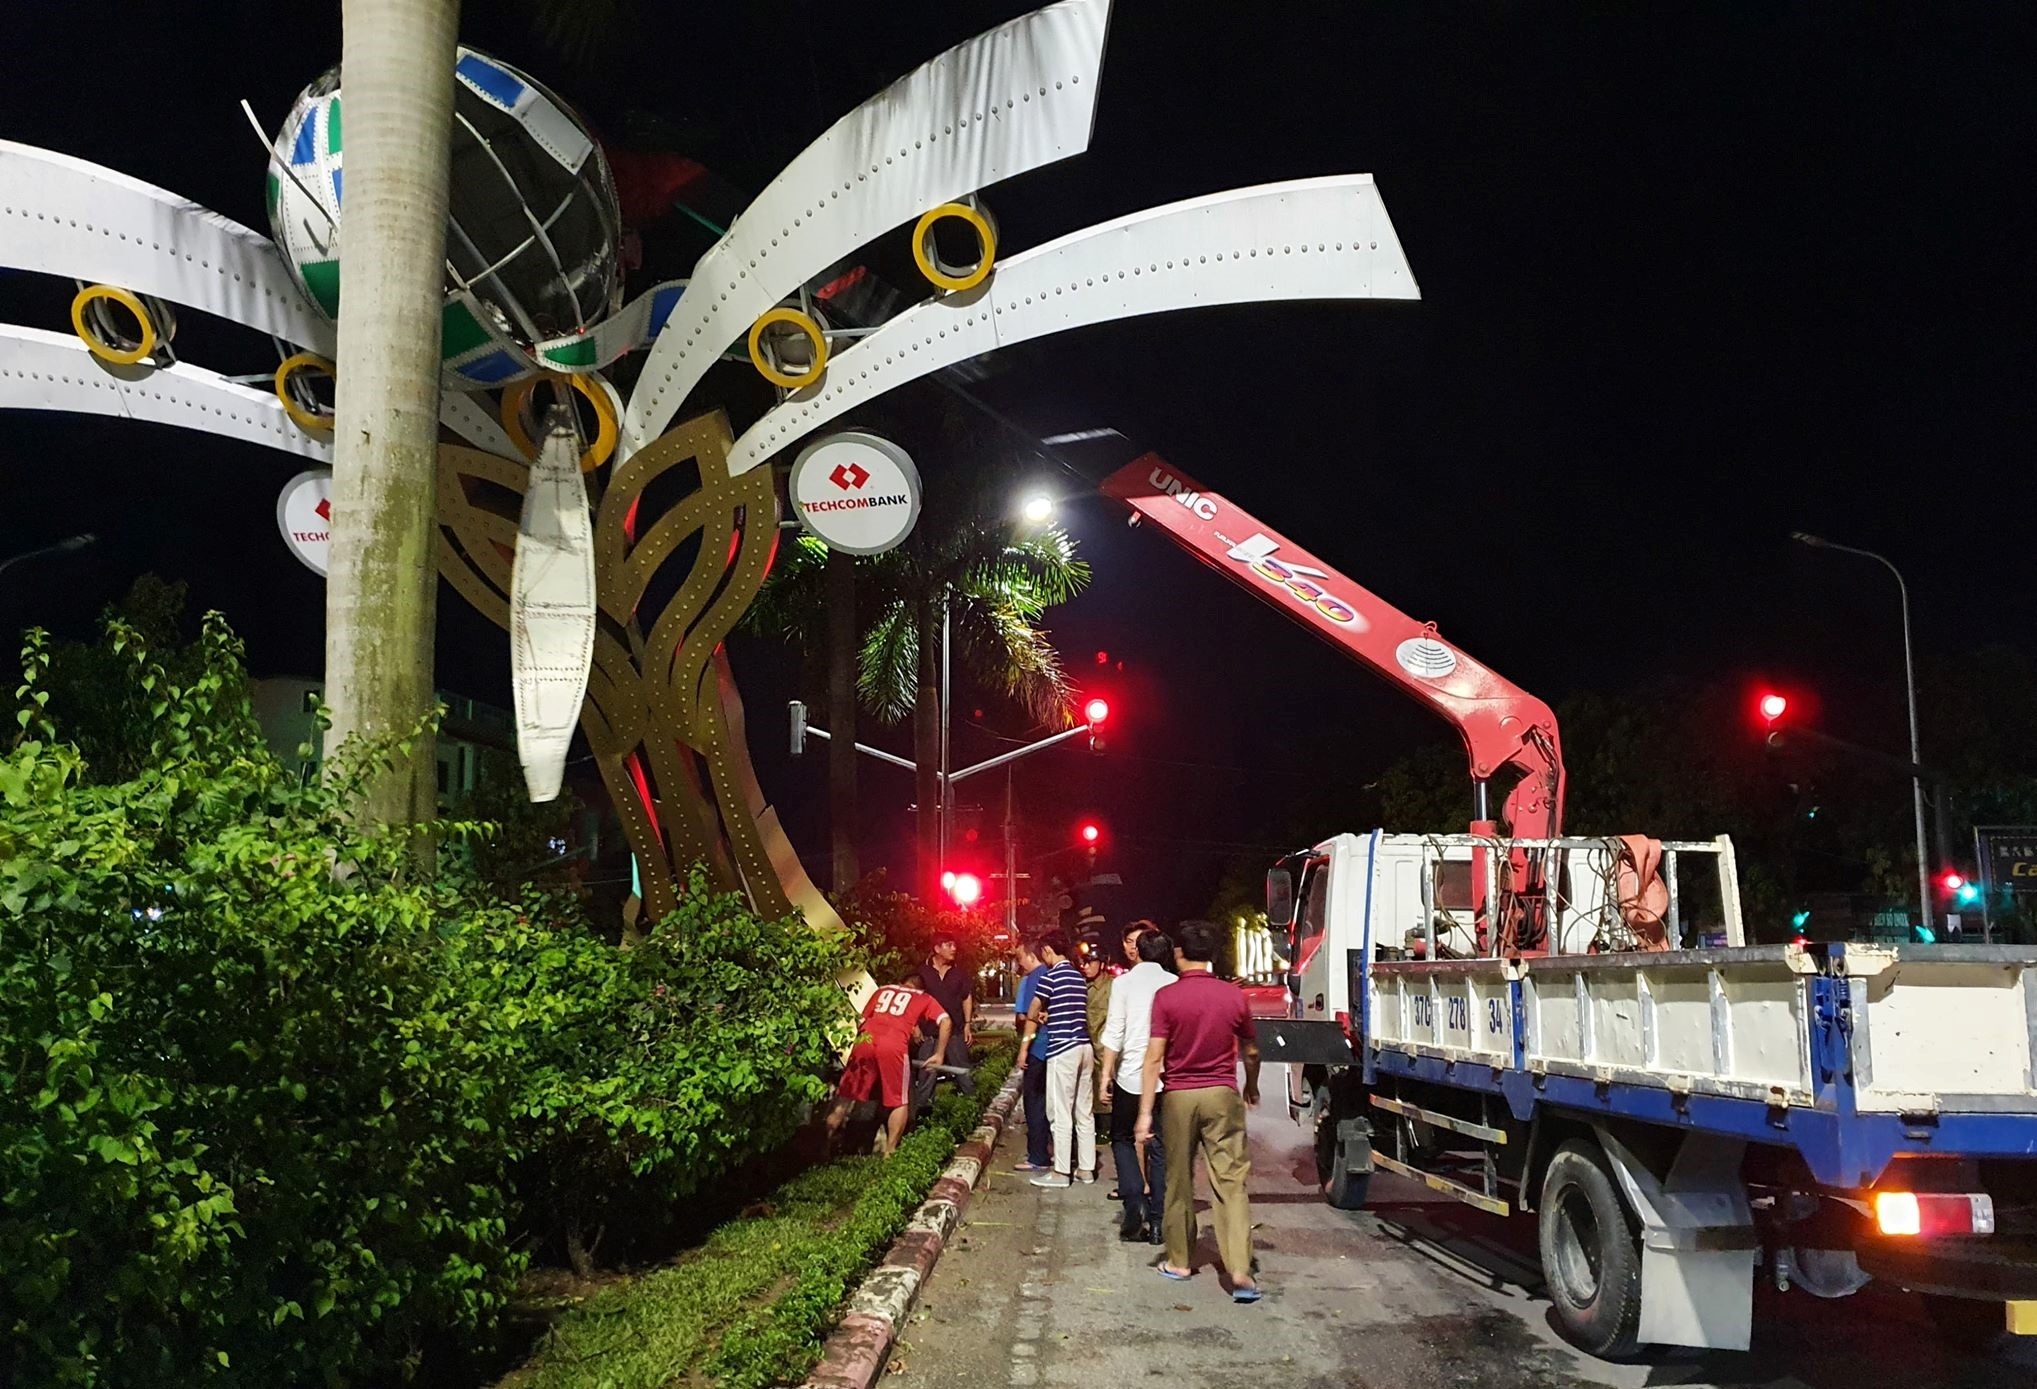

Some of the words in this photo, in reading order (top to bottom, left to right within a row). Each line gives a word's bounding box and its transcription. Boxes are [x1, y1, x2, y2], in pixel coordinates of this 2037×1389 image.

[804, 494, 908, 513] TECHCOMBANK
[1149, 466, 1219, 521] UNIC
[874, 989, 912, 1016] 99
[1449, 997, 1466, 1031] 278
[1488, 999, 1503, 1034] 34
